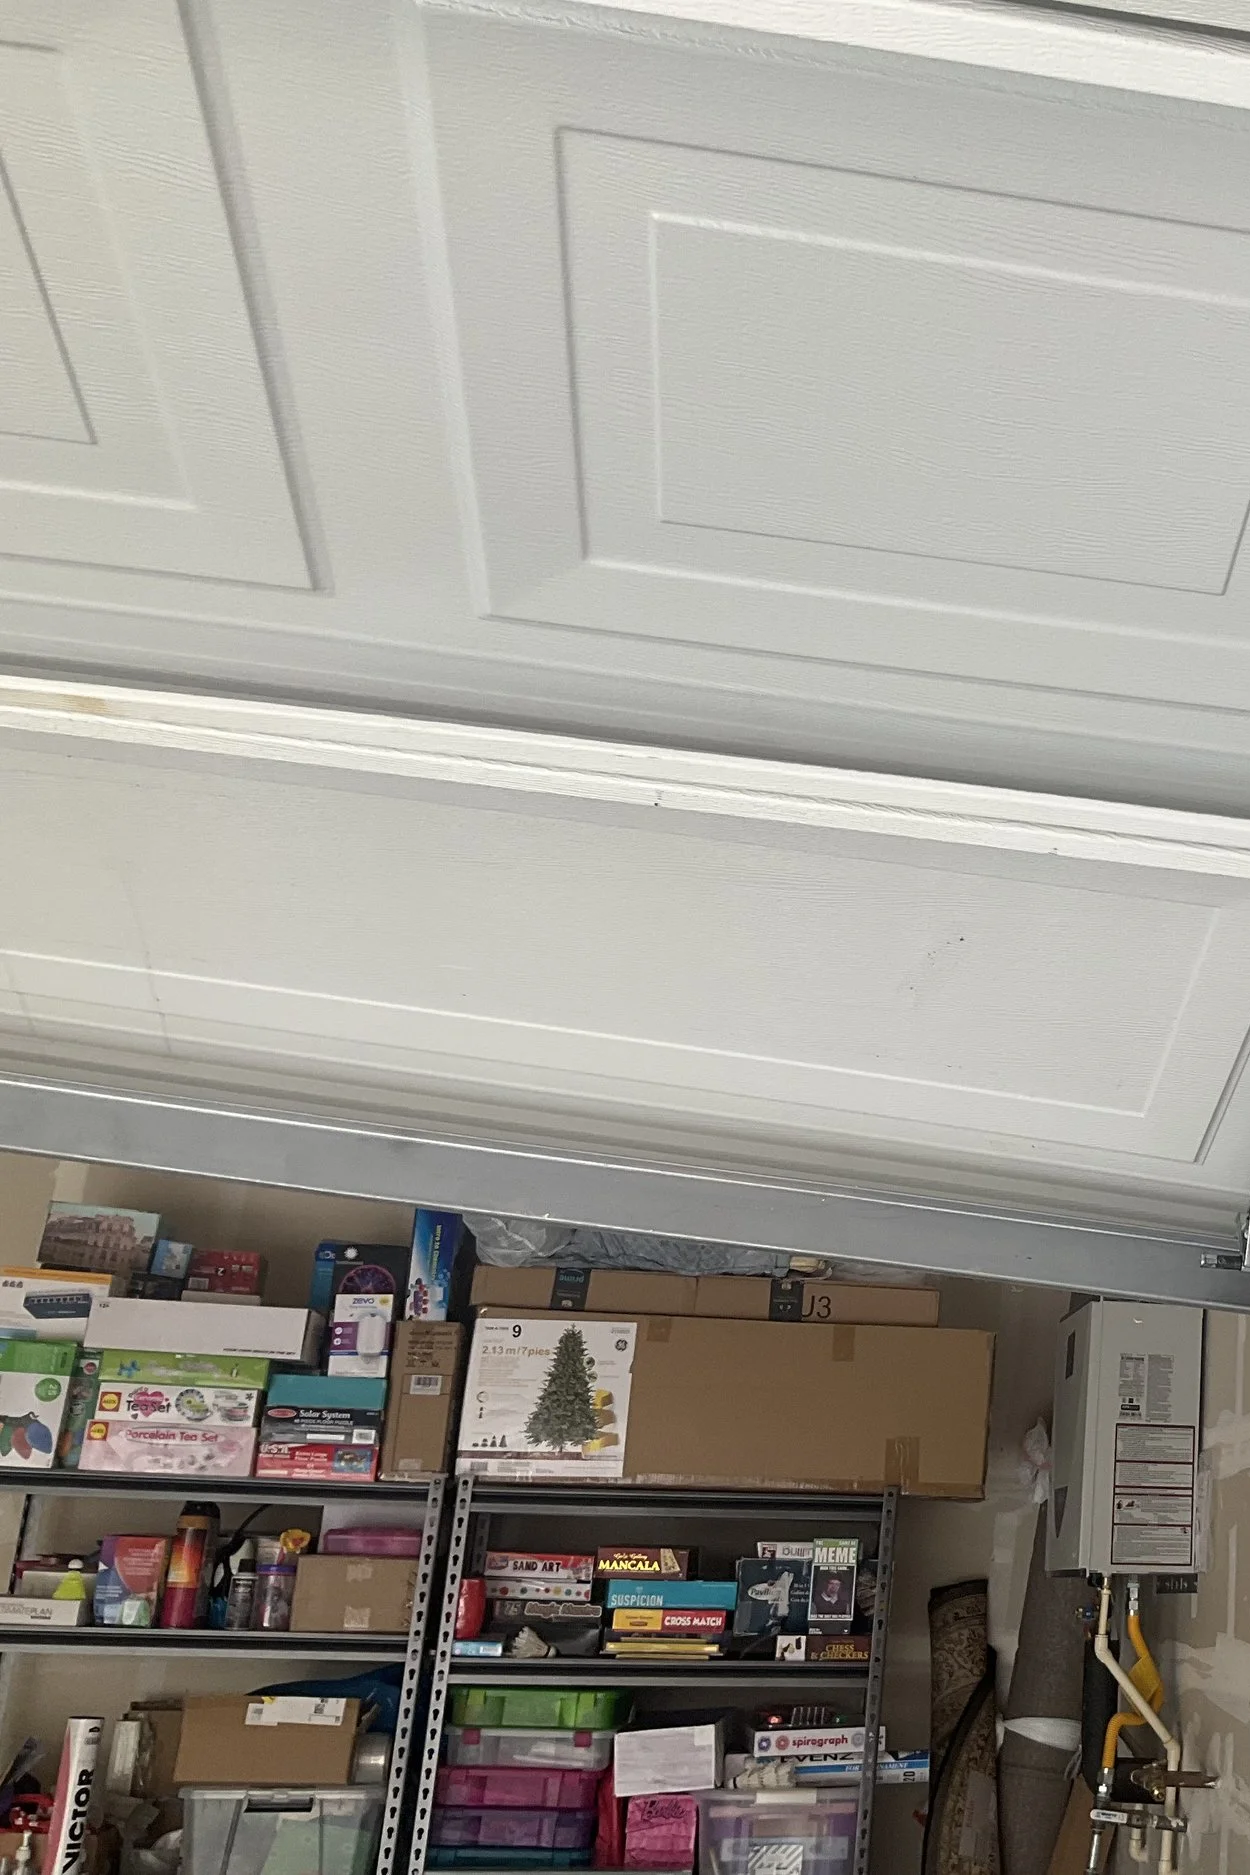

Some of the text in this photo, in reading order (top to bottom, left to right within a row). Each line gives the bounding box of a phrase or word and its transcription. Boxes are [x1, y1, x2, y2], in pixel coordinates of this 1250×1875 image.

[352, 1297, 375, 1305] ZEVO
[512, 1324, 522, 1338] 9
[126, 1400, 172, 1413] Tea Set
[299, 1409, 321, 1418] Solar
[322, 1410, 351, 1420] System
[126, 1429, 219, 1443] Porcelain Tea Set
[814, 1547, 857, 1563] MEME
[513, 1560, 562, 1572] SAND ART
[597, 1559, 661, 1572] MANCALA
[610, 1594, 664, 1607] SUSPICION
[664, 1616, 691, 1626] CROSS
[692, 1617, 722, 1626] MATCH
[825, 1644, 855, 1652] CHESS
[820, 1650, 869, 1660] CHECKERS
[792, 1734, 848, 1748] spirograph
[845, 1764, 860, 1772] FOR
[903, 1770, 916, 1782] 20
[62, 1768, 95, 1874] VICTOR
